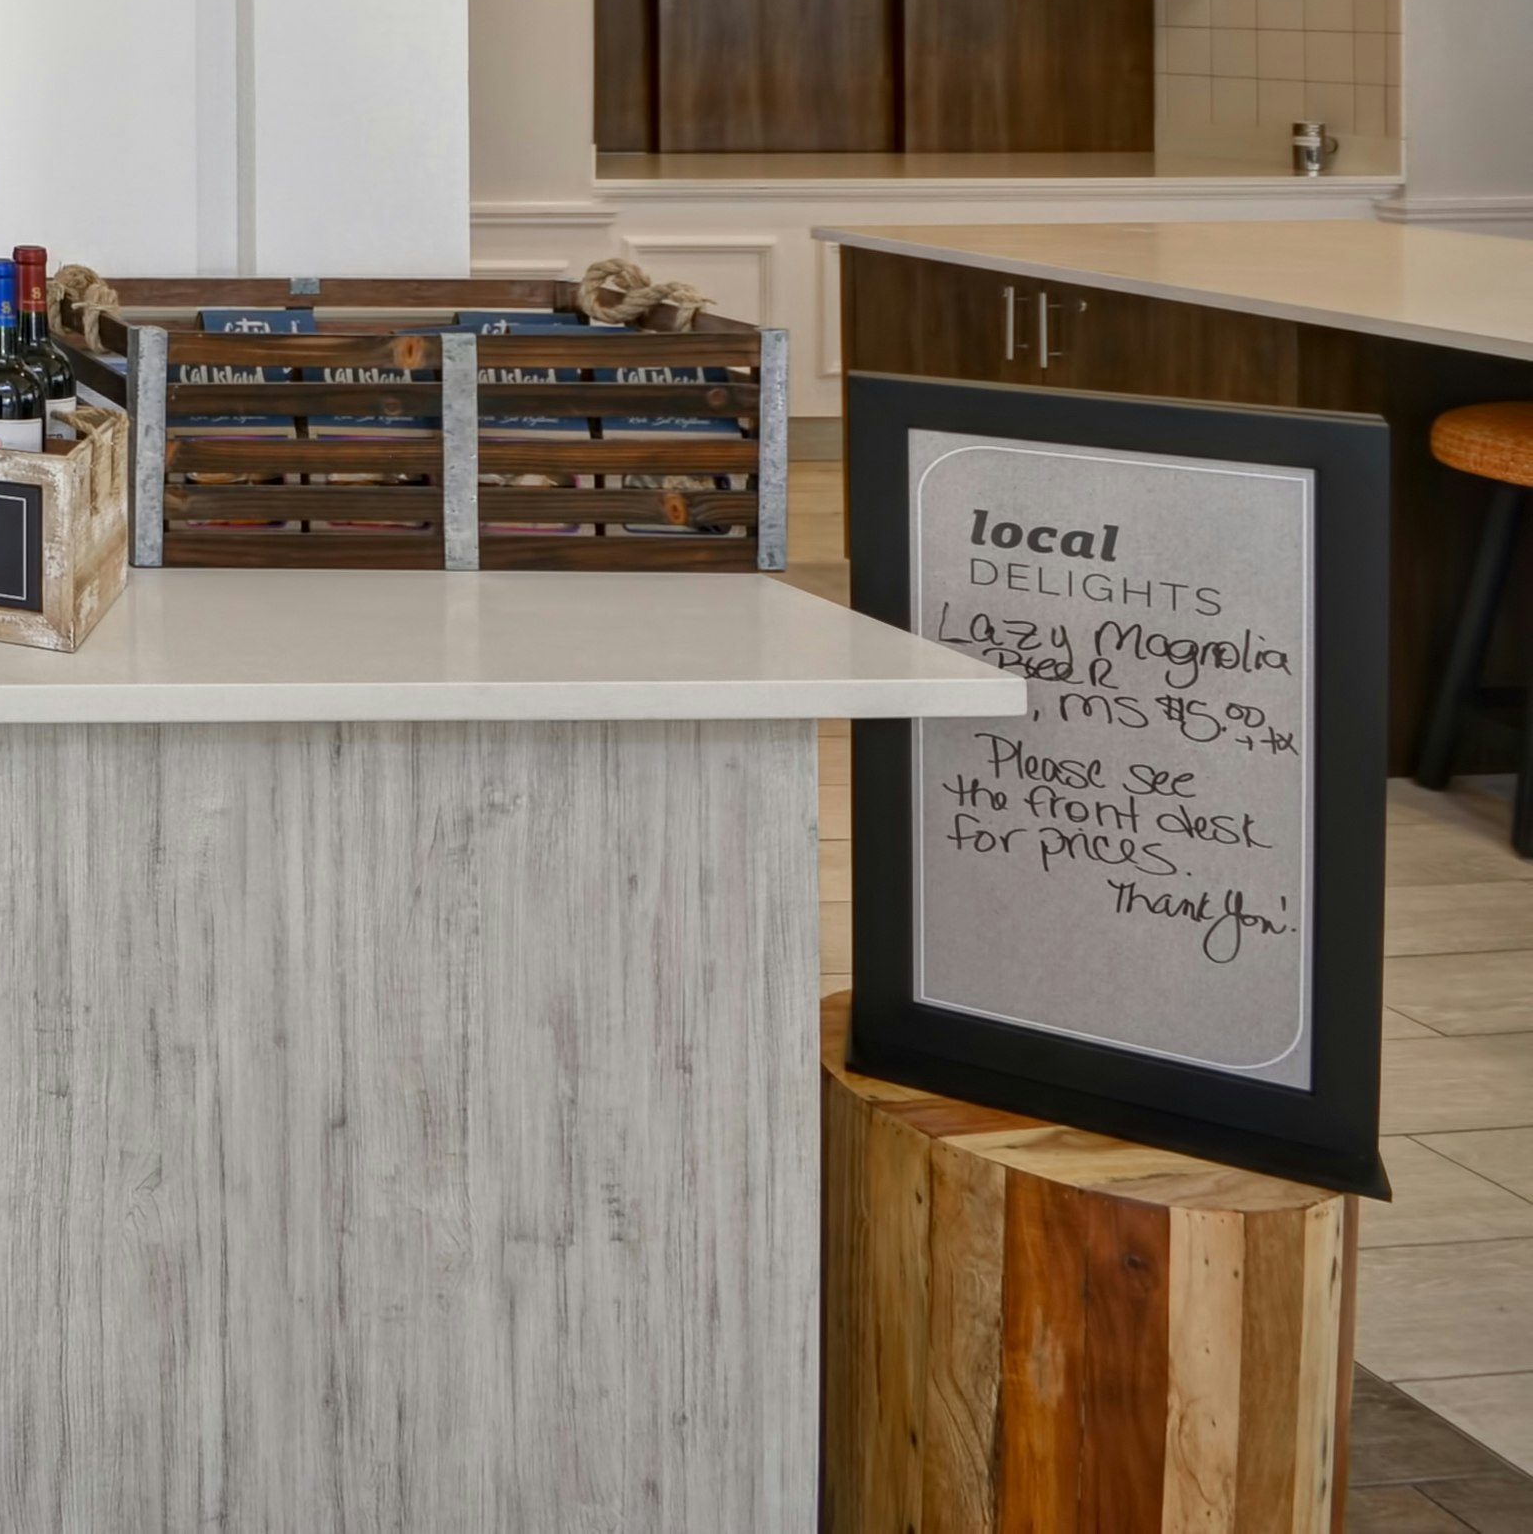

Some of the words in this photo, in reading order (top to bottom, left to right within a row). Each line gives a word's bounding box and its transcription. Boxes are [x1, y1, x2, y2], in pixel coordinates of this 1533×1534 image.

[970, 509, 1120, 562] local
[970, 558, 1223, 616] DELIGHTS
[1095, 621, 1291, 688] Magnolia
[974, 732, 1106, 789] Please
[1123, 764, 1196, 798] see
[943, 773, 1007, 811] the
[1023, 785, 1140, 834] front
[1157, 805, 1273, 849] desk
[947, 813, 1026, 853] for
